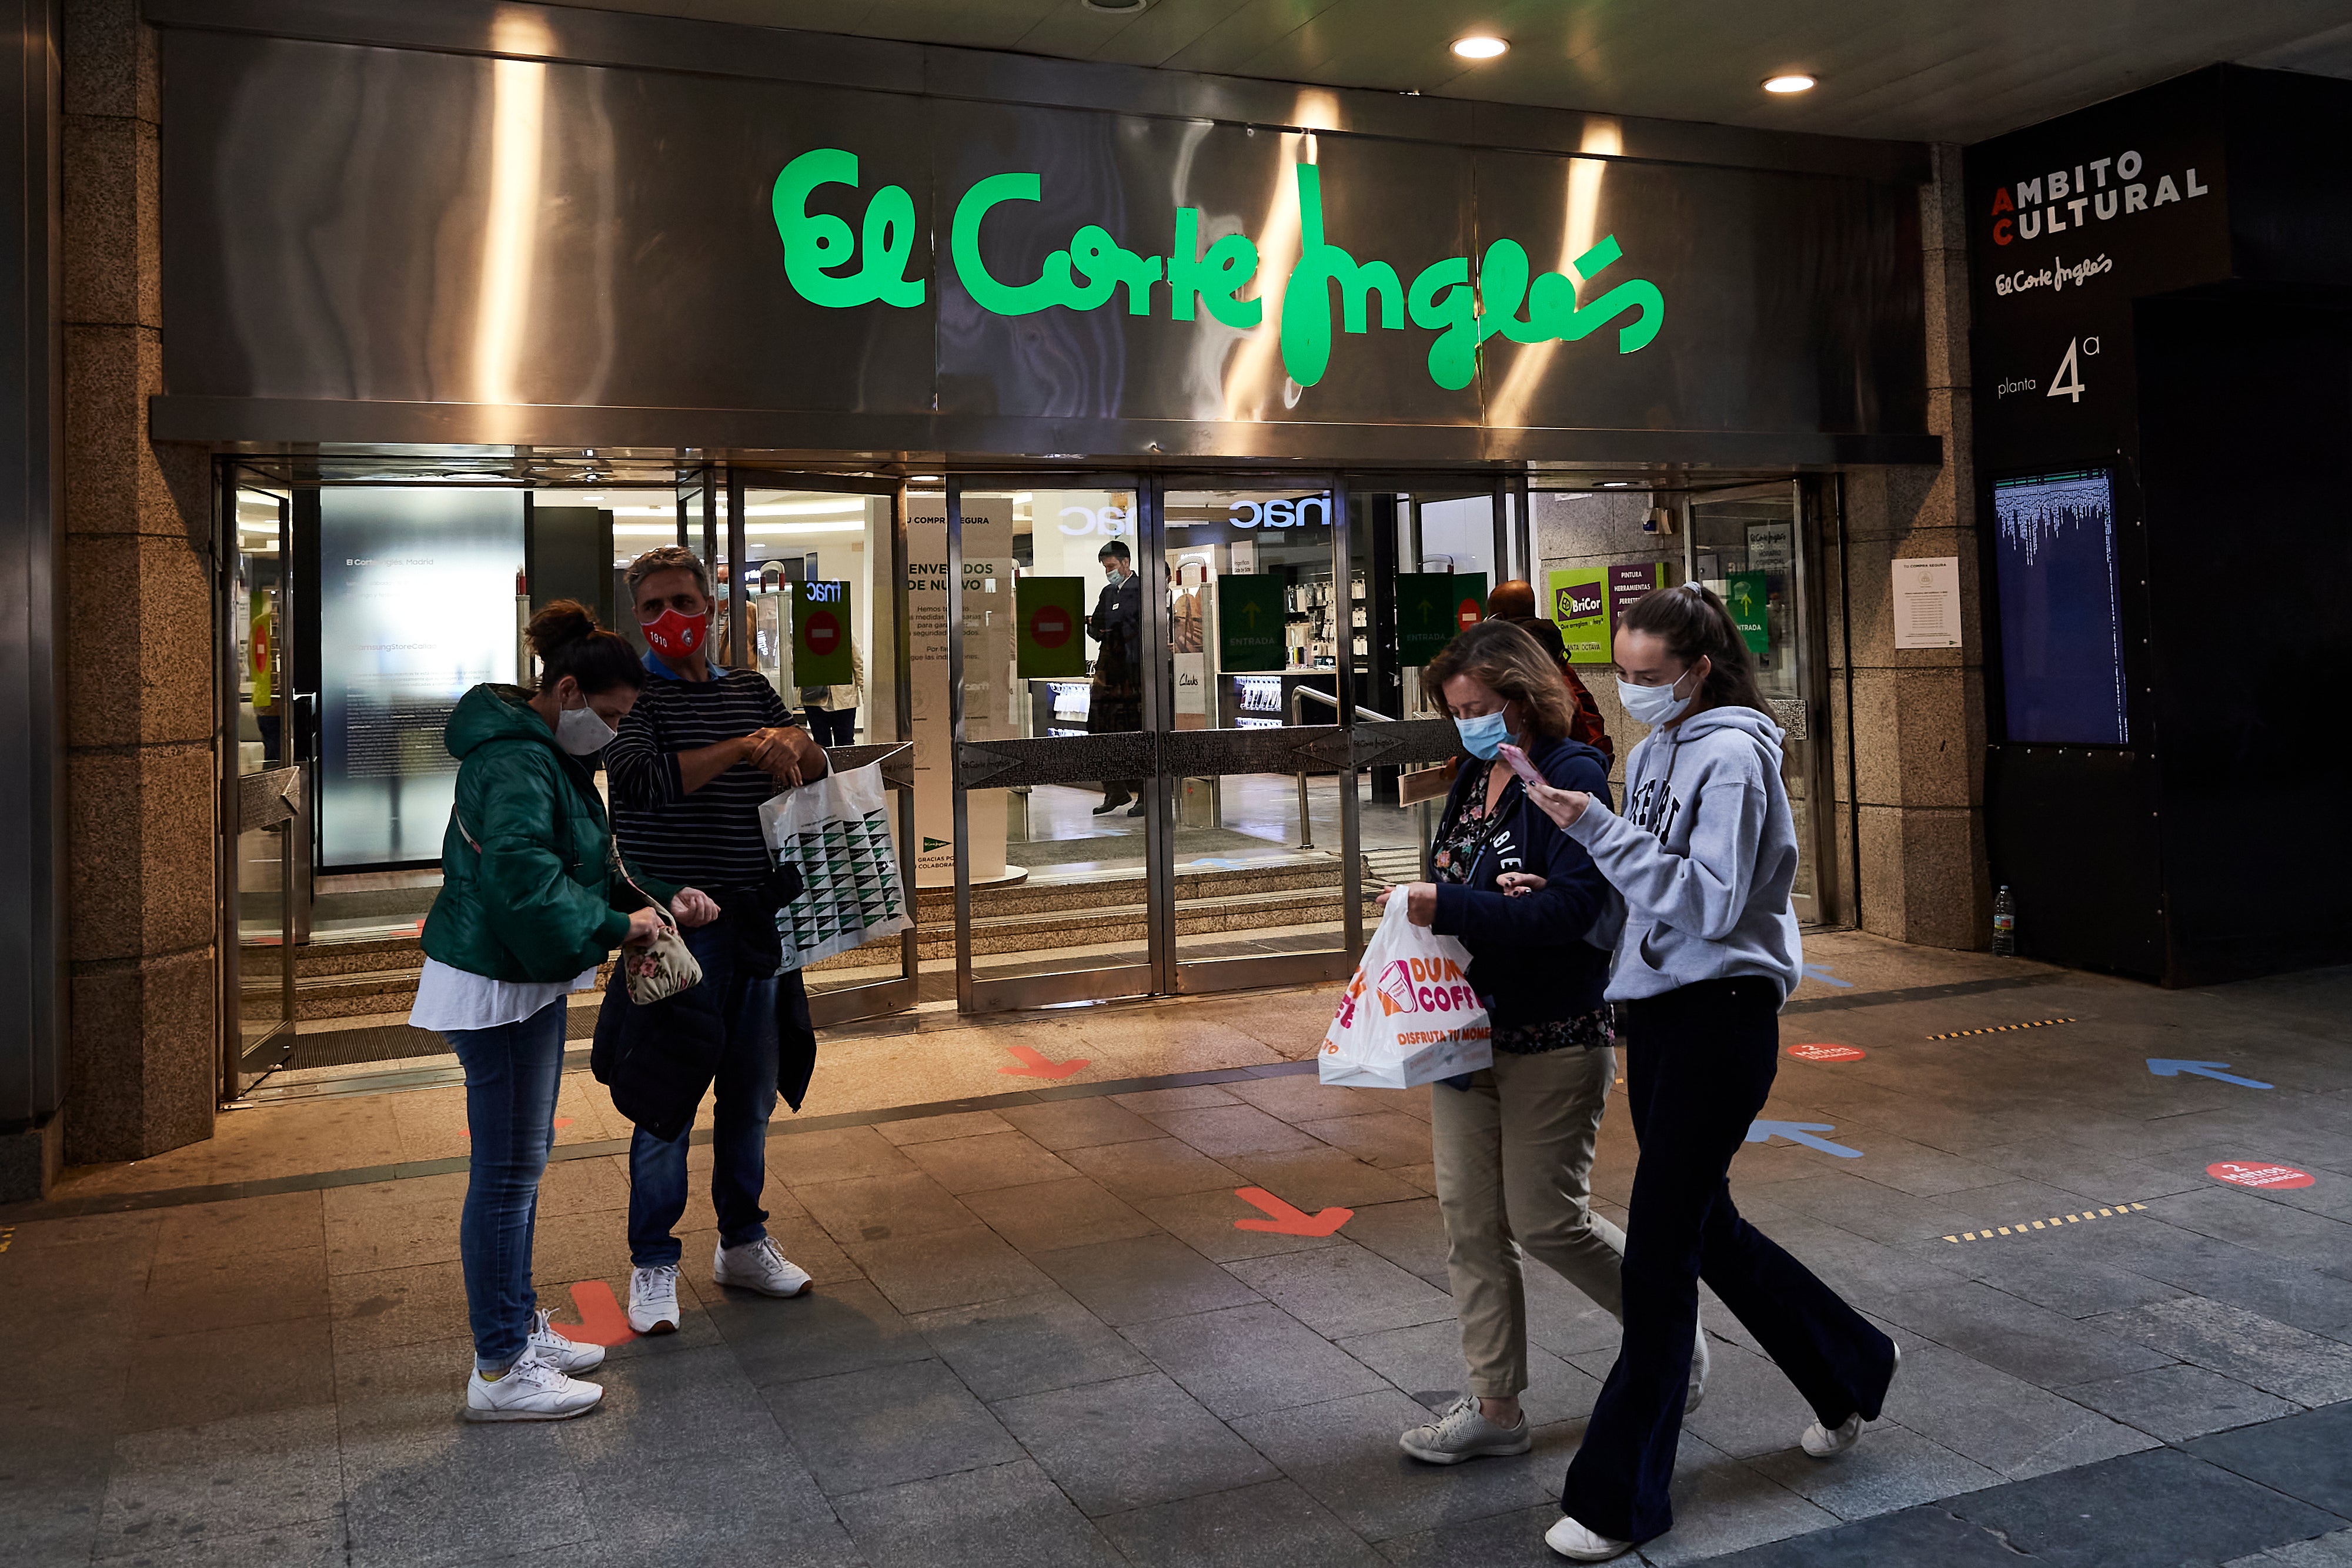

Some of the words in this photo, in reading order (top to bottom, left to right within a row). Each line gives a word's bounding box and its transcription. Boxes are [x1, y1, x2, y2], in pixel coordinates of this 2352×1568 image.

[1991, 150, 2143, 216] AMBITO
[1993, 168, 2209, 246] CULTURAL
[772, 148, 926, 307] El
[951, 172, 1262, 328] Corte
[1281, 163, 1665, 389] Inglés
[1996, 273, 2013, 295] El
[2013, 268, 2052, 292] Corte
[2054, 253, 2113, 292] Inglés
[1998, 377, 2036, 399] planta
[908, 563, 993, 574] ENVEDOS
[908, 580, 926, 590] DE
[930, 580, 981, 590] NUVO
[1613, 583, 1651, 591] HERRAMIENTAS
[1572, 597, 1601, 613] BriCor
[1619, 596, 1643, 604] FERRET
[650, 631, 667, 648] 1910
[1230, 637, 1275, 646] ENTRADA
[1406, 633, 1446, 641] ENTRADA
[1179, 673, 1198, 686] Clarks
[1409, 957, 1467, 982] DUN
[1418, 985, 1485, 1012] COFF
[1396, 1029, 1446, 1045] DISFRUTA
[1447, 1028, 1460, 1041] TU
[1462, 1027, 1492, 1041] MOME
[1795, 1047, 1850, 1057] Metros
[2221, 1164, 2249, 1172] 2
[2221, 1167, 2287, 1181] Metros
[2243, 1173, 2305, 1186] Distancia
